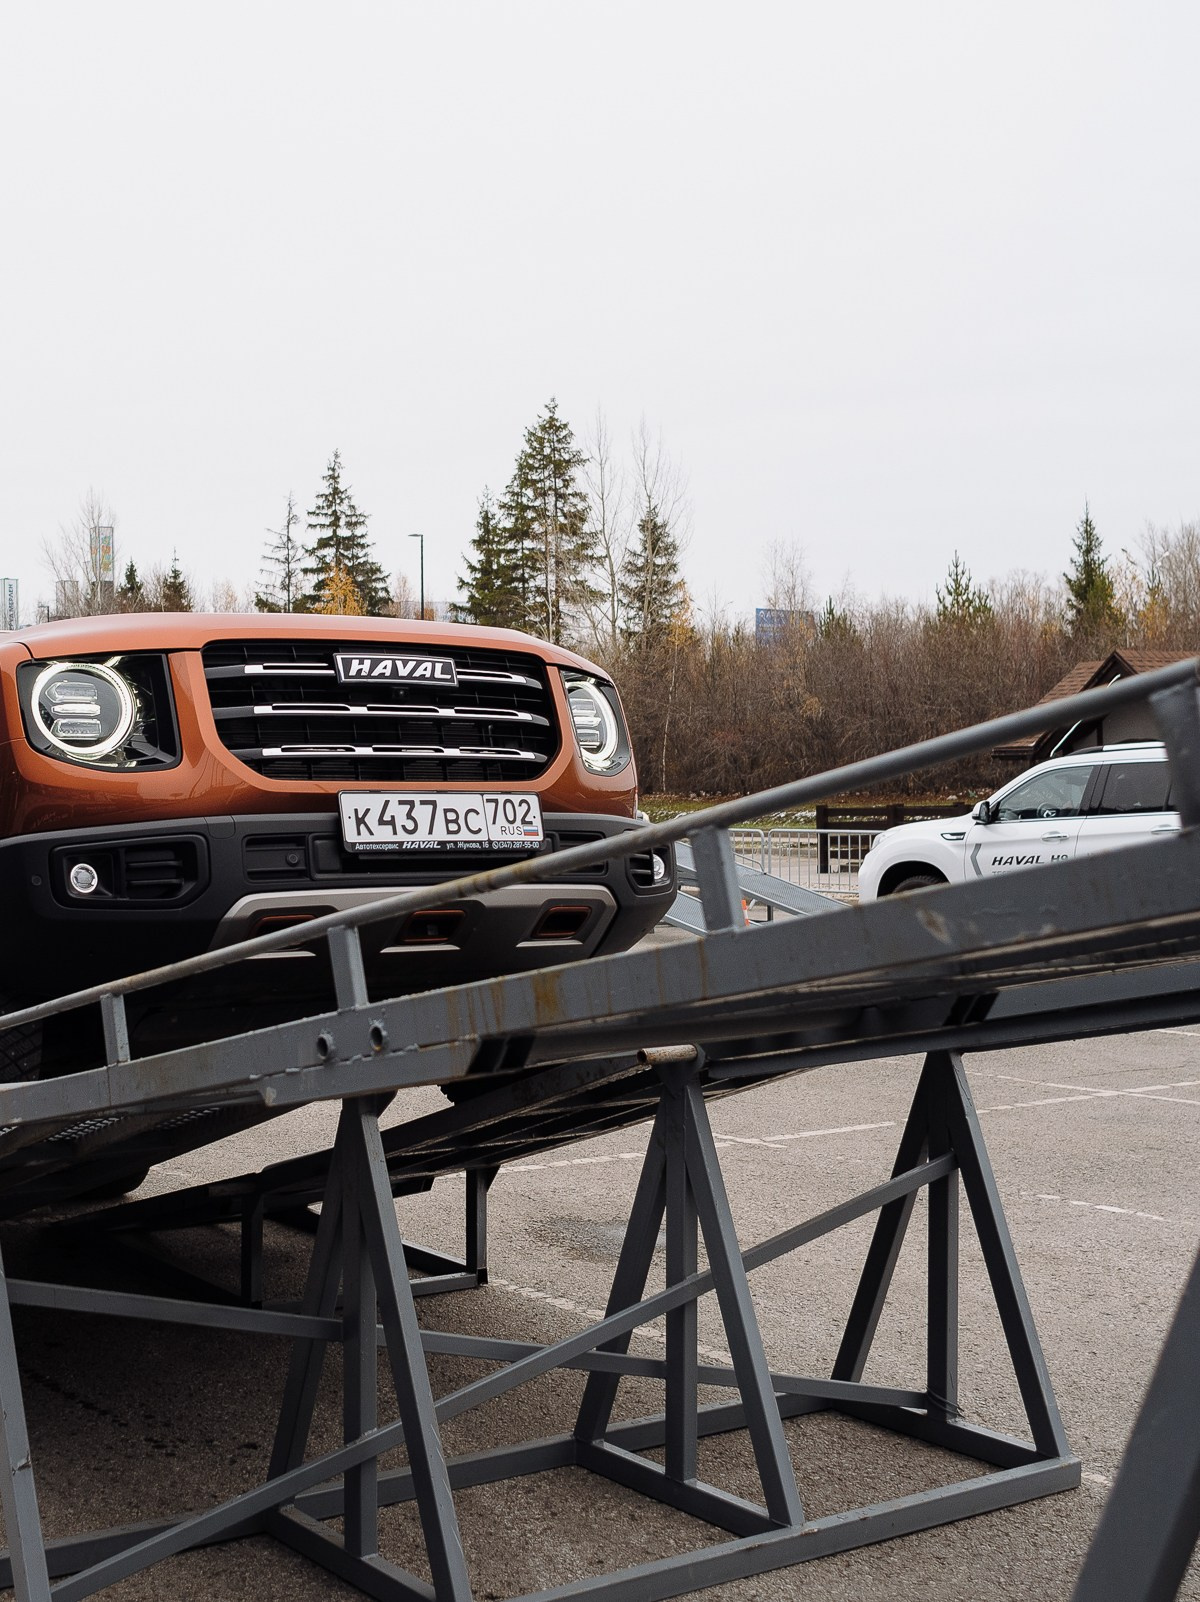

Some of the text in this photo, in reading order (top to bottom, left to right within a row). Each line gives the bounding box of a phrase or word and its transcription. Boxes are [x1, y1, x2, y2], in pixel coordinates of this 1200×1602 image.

[348, 659, 452, 679] HAVAL
[486, 798, 533, 825] 702
[501, 826, 522, 835] RUS
[355, 842, 399, 850] Автотехсервис
[402, 841, 441, 849] HAVAL
[991, 855, 1044, 865] HAVAL
